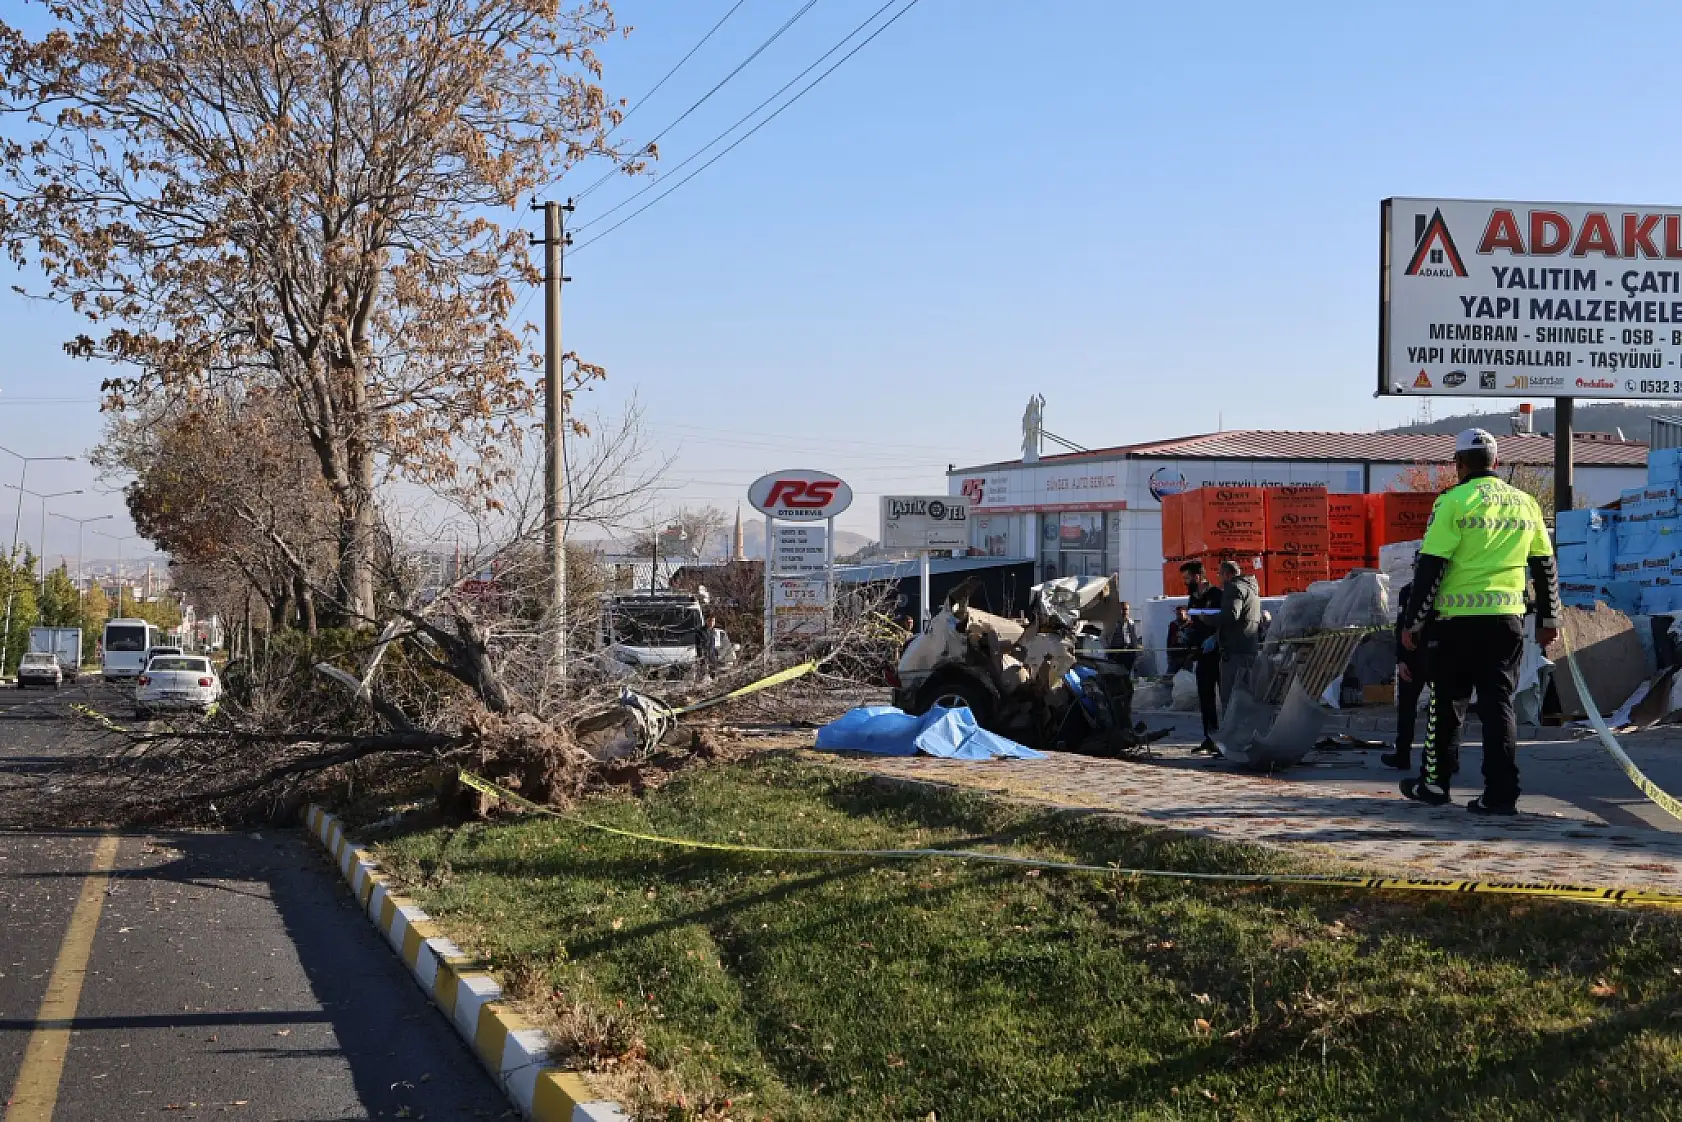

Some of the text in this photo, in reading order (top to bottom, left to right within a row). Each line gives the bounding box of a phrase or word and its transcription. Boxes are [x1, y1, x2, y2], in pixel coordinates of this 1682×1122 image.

[1418, 268, 1453, 277] ADAKLI
[1491, 266, 1596, 291] YALITIM
[1621, 269, 1680, 298] ÇATI
[1459, 295, 1682, 323] YAPI MALZEMELE
[1429, 323, 1518, 342] MEMBRAN
[1536, 326, 1604, 344] SHINGLE
[1622, 328, 1653, 346] OSB
[1407, 346, 1444, 364] YAPI
[1451, 343, 1571, 367] KİMYASALLARI
[1589, 348, 1662, 373] TAŞYÜNÜ
[1640, 380, 1669, 393] 0532
[763, 481, 840, 507] RS
